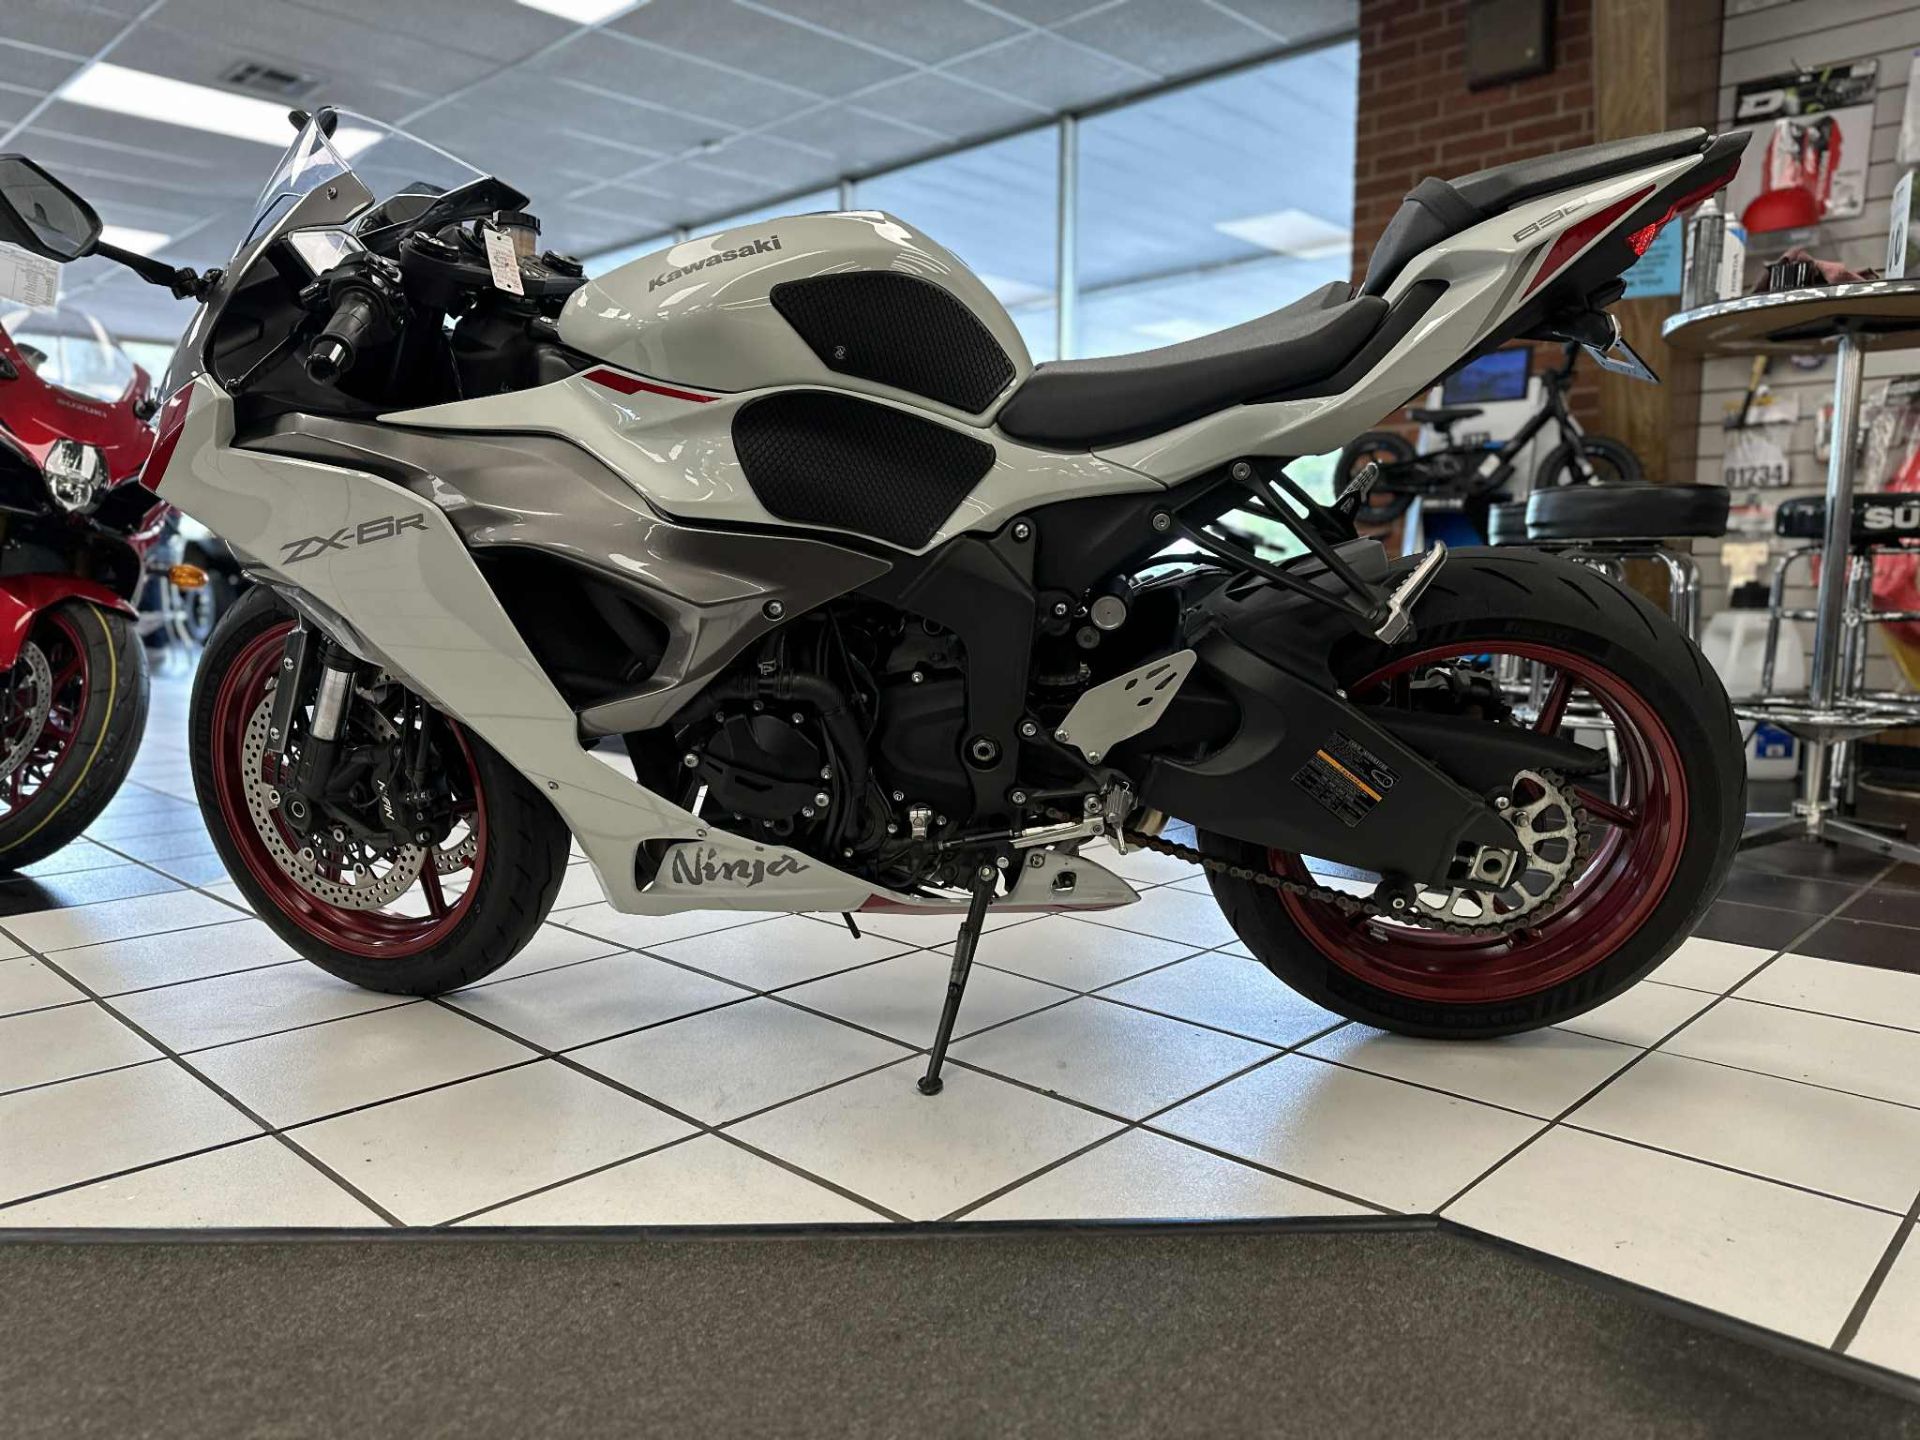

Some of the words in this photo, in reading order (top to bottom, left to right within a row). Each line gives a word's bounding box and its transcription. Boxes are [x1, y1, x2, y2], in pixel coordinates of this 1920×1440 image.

[648, 235, 782, 292] Kawasaki
[280, 513, 429, 566] ZX-6R
[672, 846, 810, 888] Ninja
